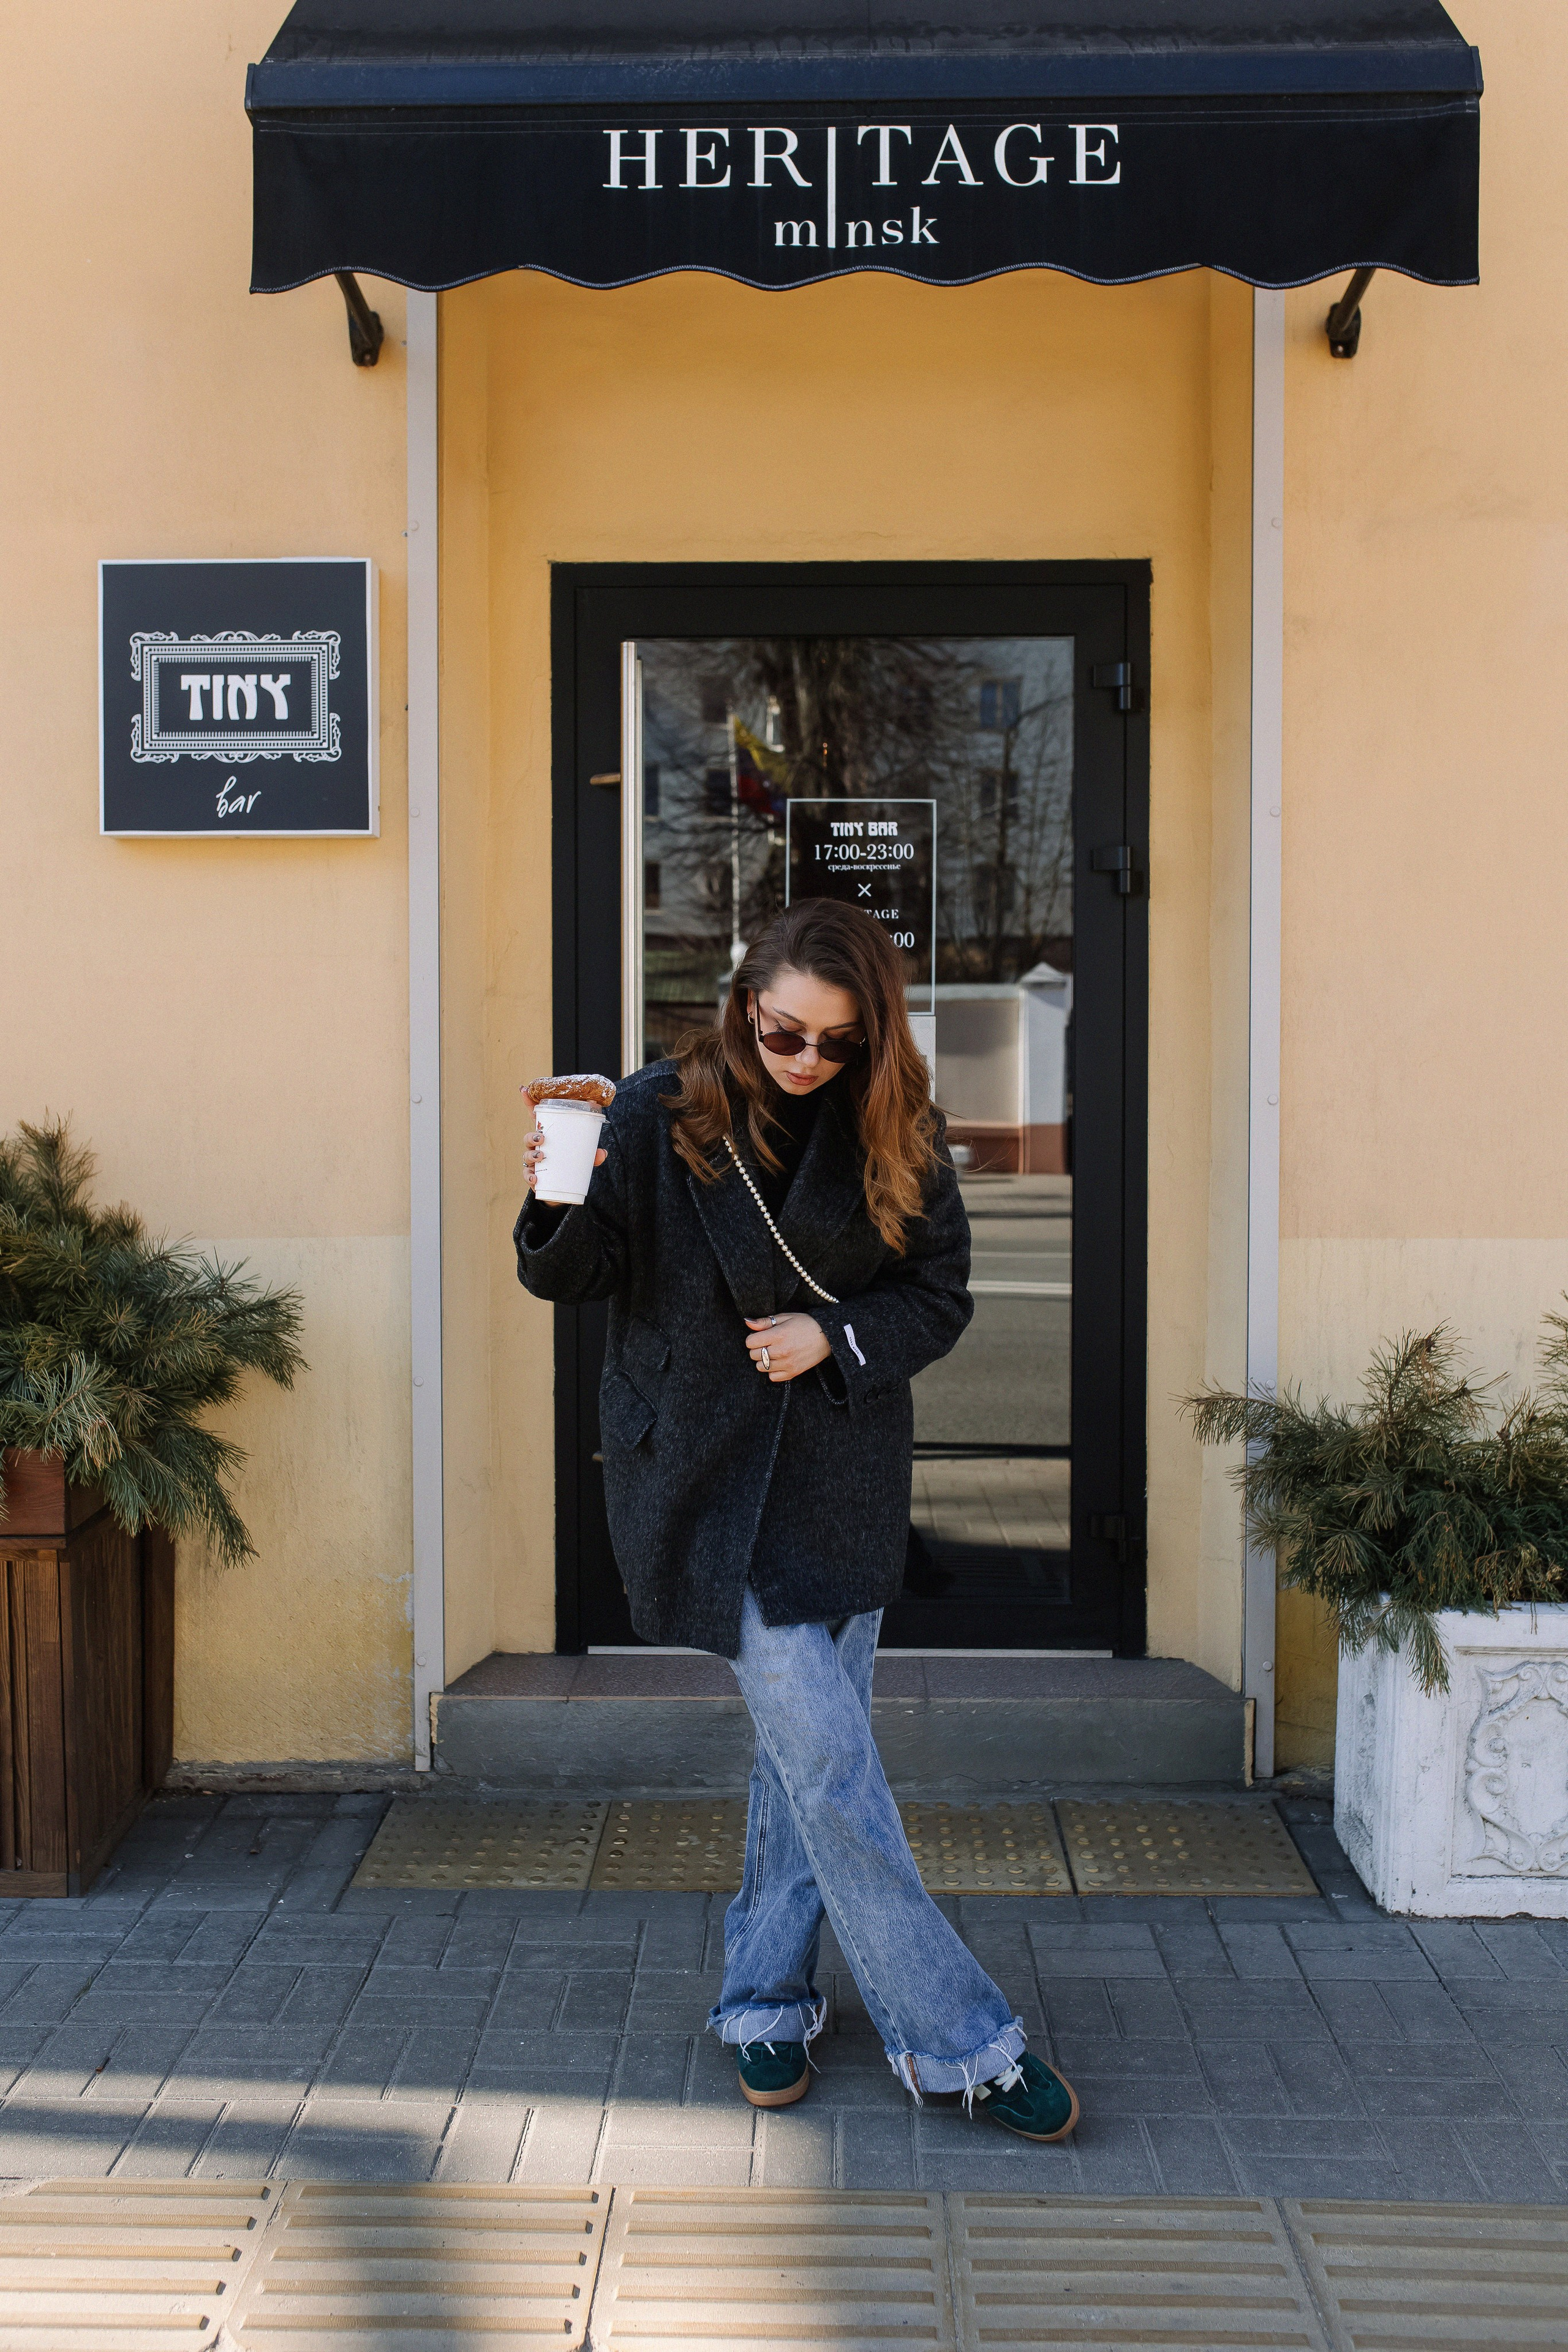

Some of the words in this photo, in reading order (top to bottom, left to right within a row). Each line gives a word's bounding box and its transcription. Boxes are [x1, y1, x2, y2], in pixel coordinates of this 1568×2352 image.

[602, 124, 1121, 189] HERITAGE
[180, 674, 291, 720] TINY
[216, 775, 262, 818] bar
[830, 822, 864, 837] TINY
[867, 821, 899, 836] BAR
[815, 843, 914, 860] 17:00-23:00
[864, 909, 899, 919] TAGE
